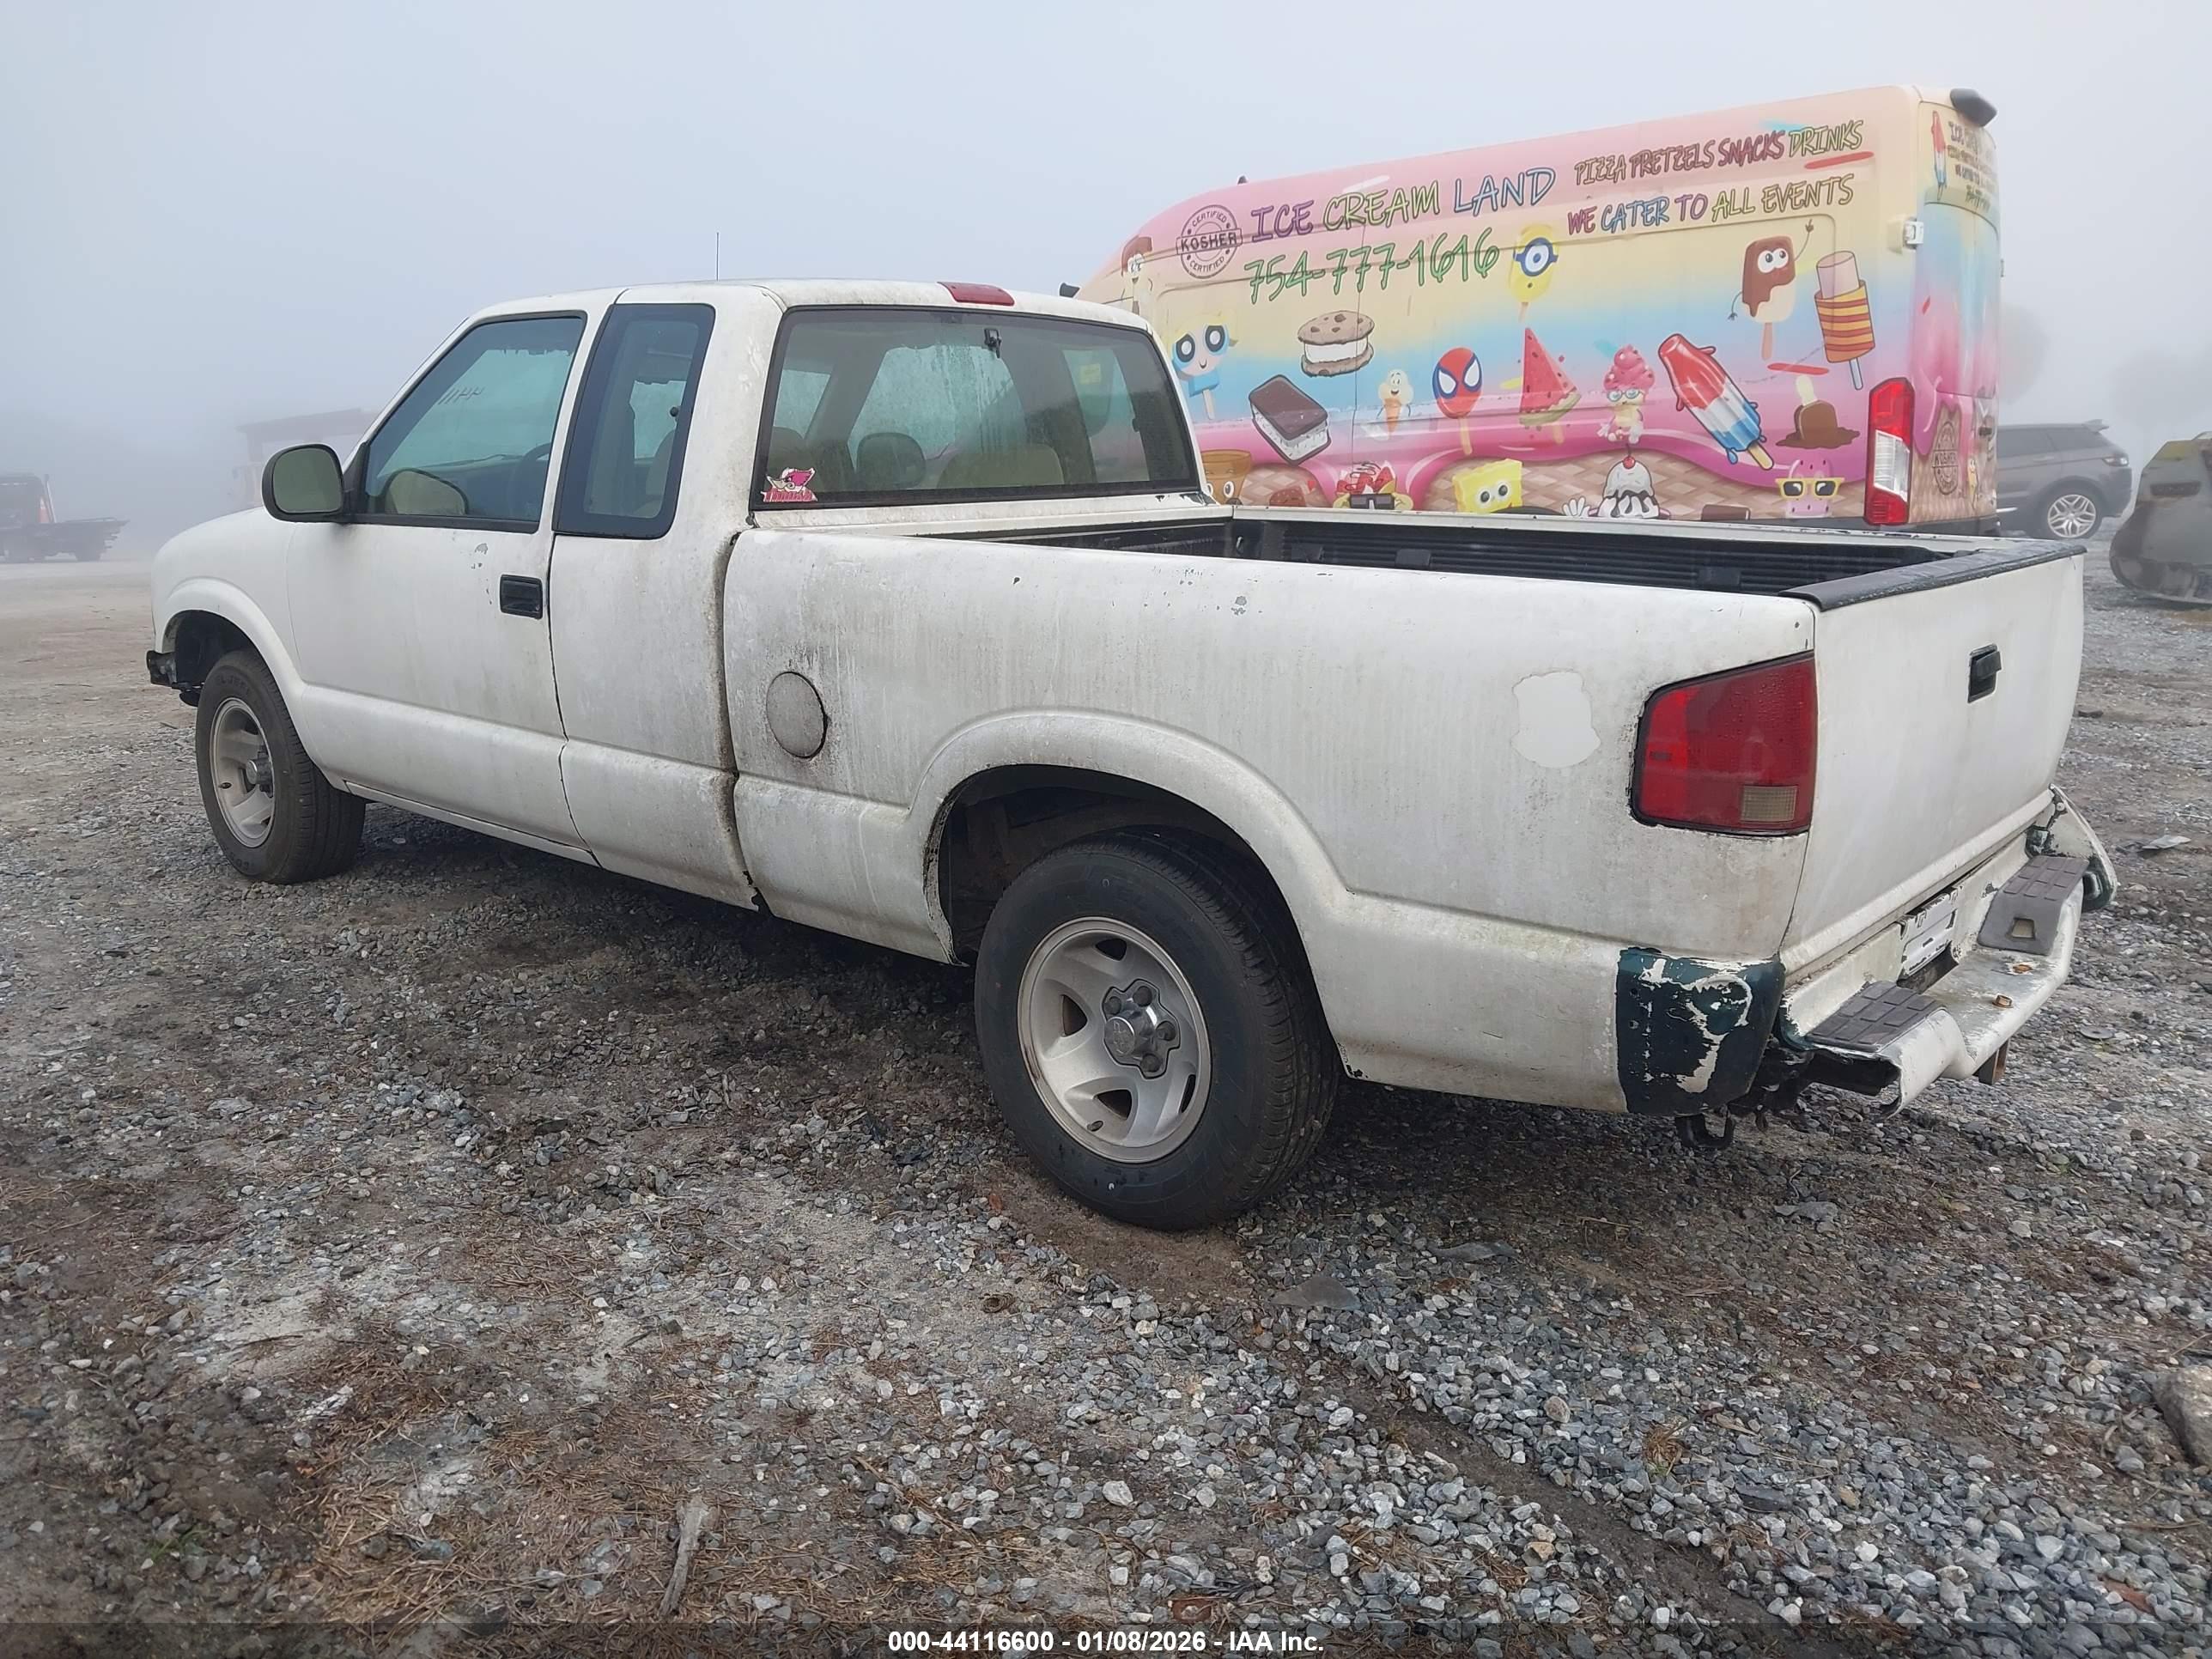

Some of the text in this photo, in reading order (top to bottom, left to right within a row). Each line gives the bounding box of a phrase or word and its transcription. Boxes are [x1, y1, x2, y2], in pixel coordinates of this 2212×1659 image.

[1573, 118, 1864, 185] PIZZA PRETZELS SNACKS DRINKS
[1192, 210, 1227, 227] CERTIFIED
[1250, 167, 1557, 243] ICE CREAM LAND
[1567, 173, 1856, 235] WE CATER TO ALL EVENTS
[1181, 232, 1237, 252] KOSHER
[1189, 256, 1224, 272] CERTIFIED
[1243, 227, 1501, 305] 754-777-1616
